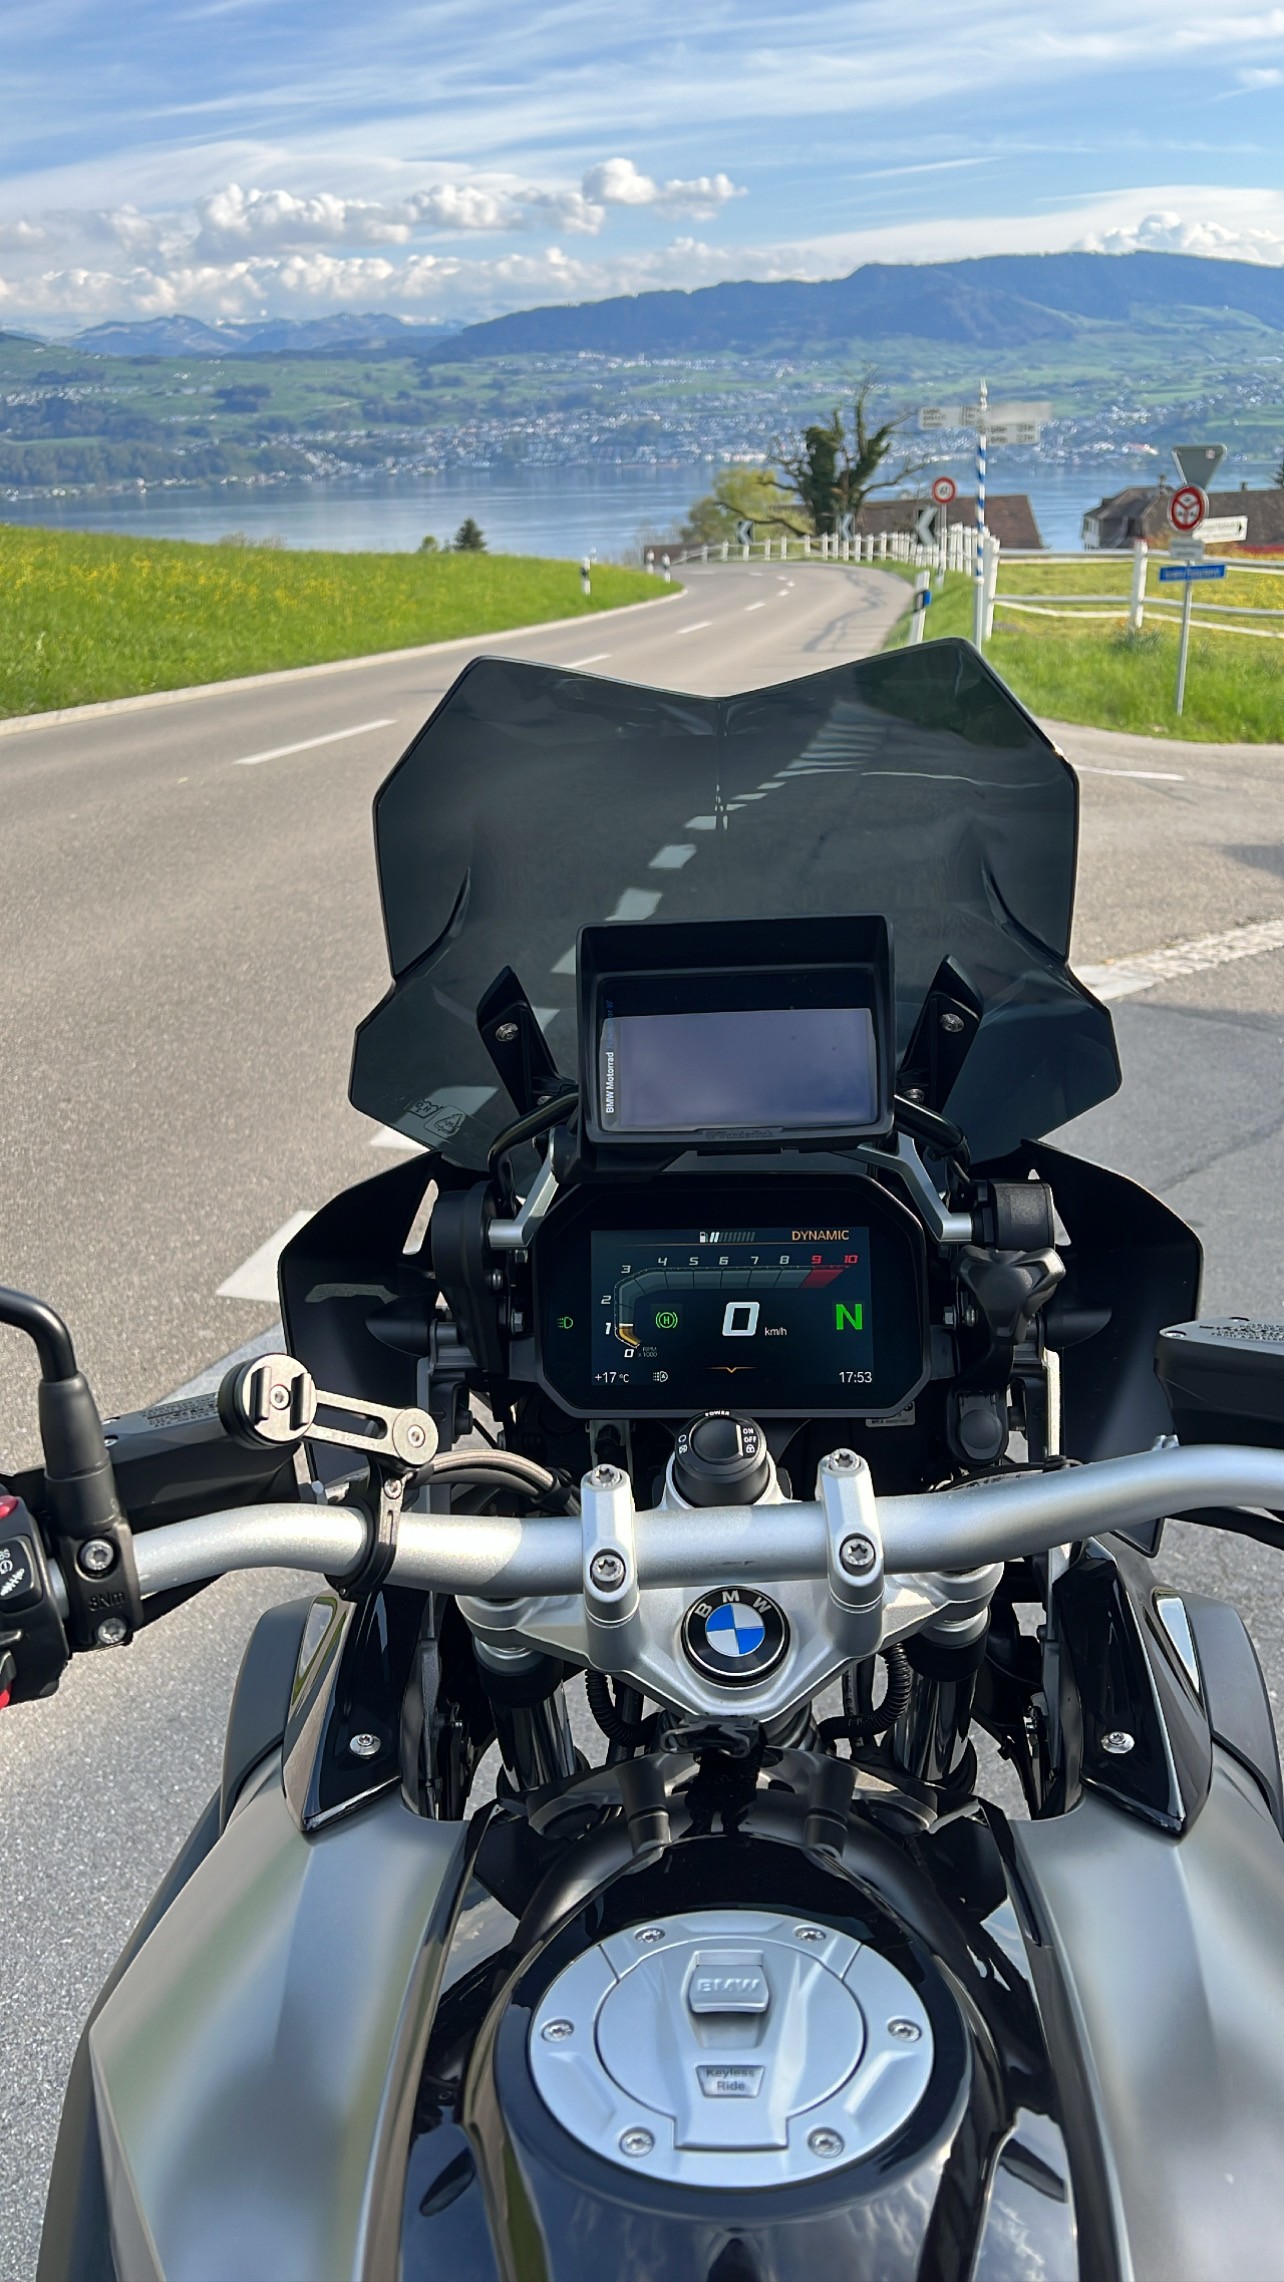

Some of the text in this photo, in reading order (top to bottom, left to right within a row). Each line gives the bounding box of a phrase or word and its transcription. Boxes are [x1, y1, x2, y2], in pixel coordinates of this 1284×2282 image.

[606, 1052, 614, 1090] Motorrad
[606, 1091, 614, 1113] BMW
[791, 1230, 850, 1240] DYNAMIC
[658, 1254, 858, 1266] 4 5 6 7 8 9 10
[621, 1265, 631, 1273] 3
[601, 1295, 611, 1304] 2
[722, 1301, 787, 1336] 0 km/h
[835, 1303, 863, 1330] N
[605, 1322, 611, 1335] 1
[624, 1349, 634, 1358] 0
[595, 1372, 617, 1383] +17
[838, 1371, 873, 1383] 17:53
[704, 1409, 730, 1417] POWER
[0, 1548, 11, 1560] BS
[694, 1590, 772, 1619] BMW
[697, 1978, 761, 1992] BMW
[706, 2067, 756, 2079] Keyless
[717, 2081, 746, 2092] Ride
